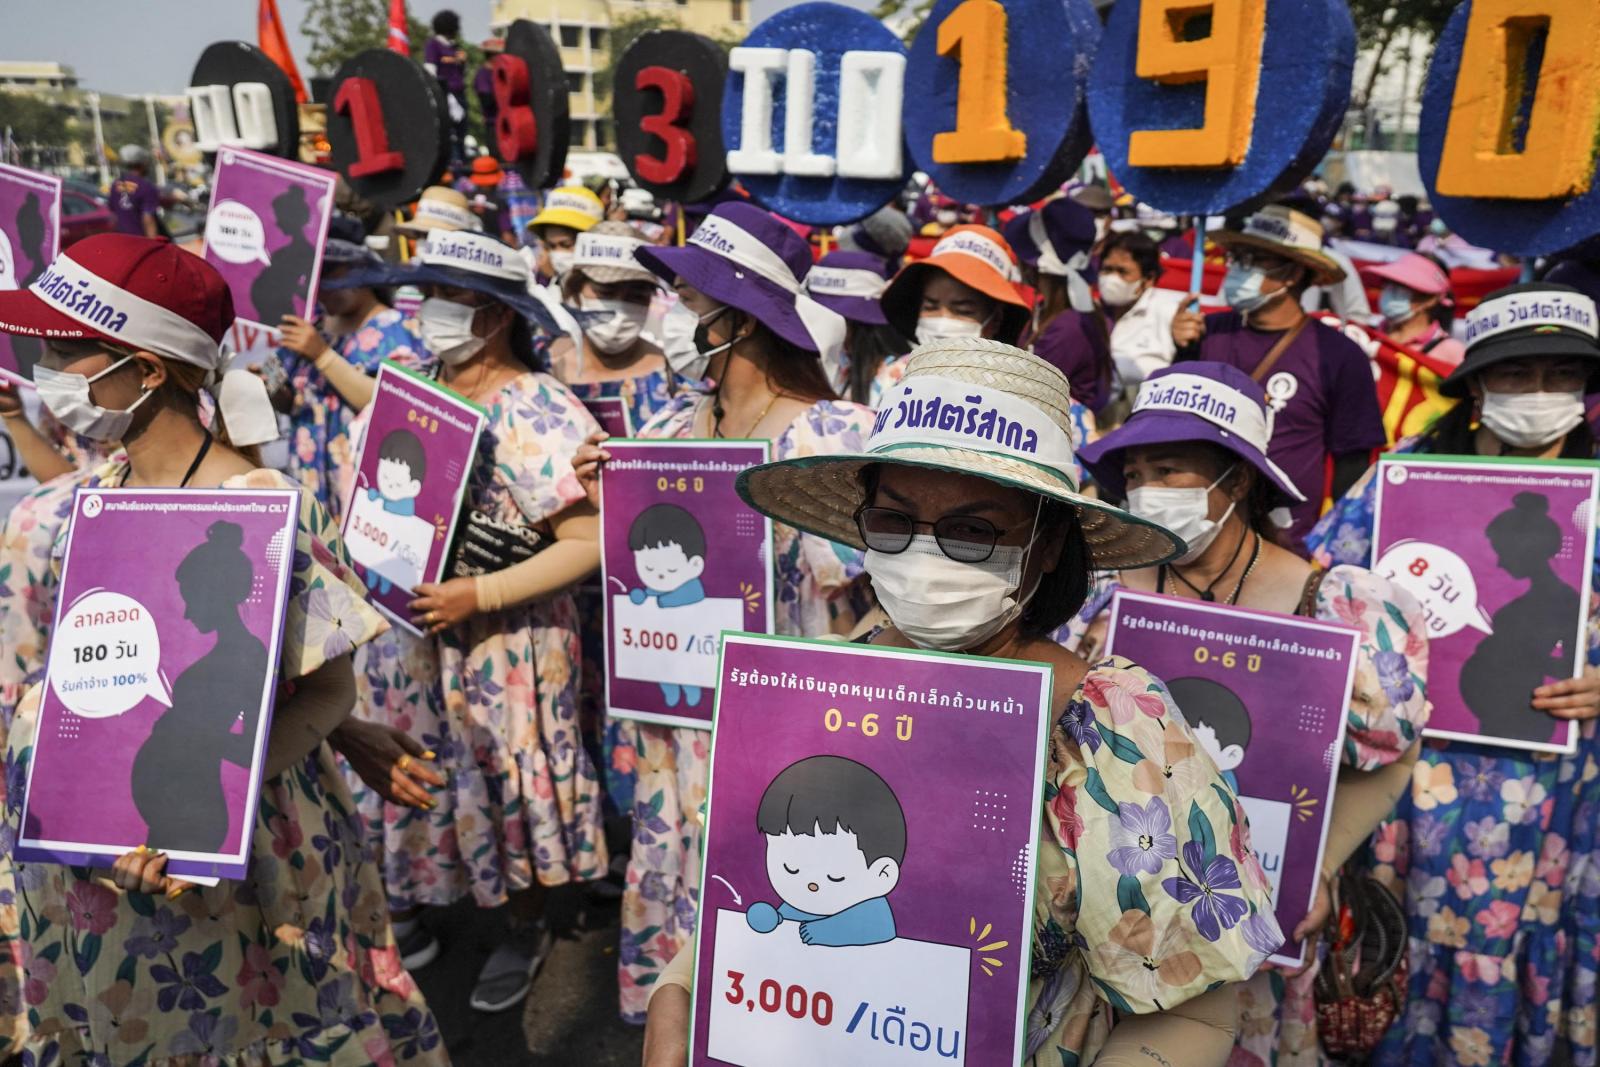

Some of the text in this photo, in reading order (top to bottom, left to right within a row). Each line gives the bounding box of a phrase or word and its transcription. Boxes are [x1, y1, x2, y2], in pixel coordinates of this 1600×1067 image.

[932, 0, 1027, 163] 1
[1128, 0, 1266, 167] 9
[333, 76, 405, 178] 1
[491, 54, 537, 163] 8
[635, 66, 696, 184] 3
[0, 321, 84, 338] RIGINAL BRAND
[894, 386, 1039, 454] วันสตรีสากล
[1144, 382, 1237, 424] วันสตรีสากล
[657, 477, 687, 493] 0-6
[1429, 573, 1461, 604] วัน
[74, 607, 140, 629] ลาคลอด
[73, 640, 138, 664] 180 วัน
[622, 628, 678, 651] 3,000
[1194, 646, 1263, 673] 0-6 ปี
[112, 672, 149, 687] 100%
[730, 667, 1025, 716] รัฐต้องให้เงินอุดหนุนเด็กเล็กถ้วนหน้า
[823, 707, 914, 742] 0-6 ปี
[725, 969, 961, 1059] 3,000 /เดือน
